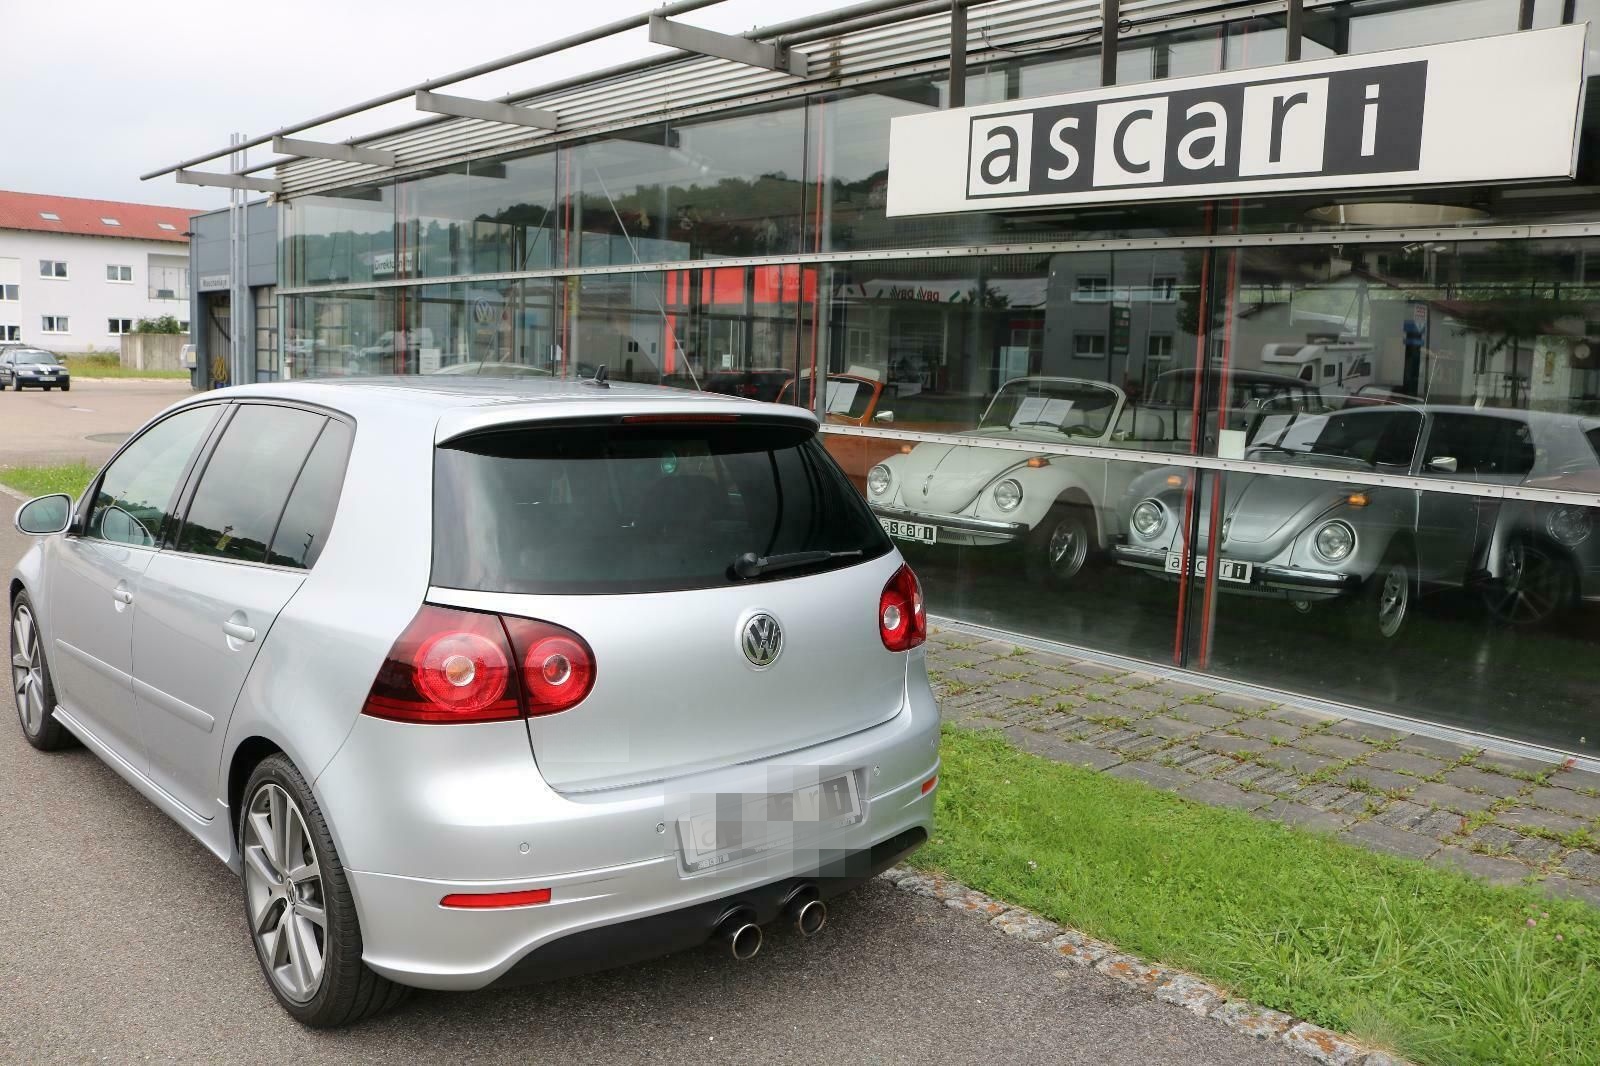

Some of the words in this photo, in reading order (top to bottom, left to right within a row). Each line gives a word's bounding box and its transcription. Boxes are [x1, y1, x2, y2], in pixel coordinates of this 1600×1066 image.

[977, 82, 1381, 187] ascari
[882, 520, 931, 540] ascari
[1171, 557, 1242, 578] acri
[700, 783, 842, 848] aari
